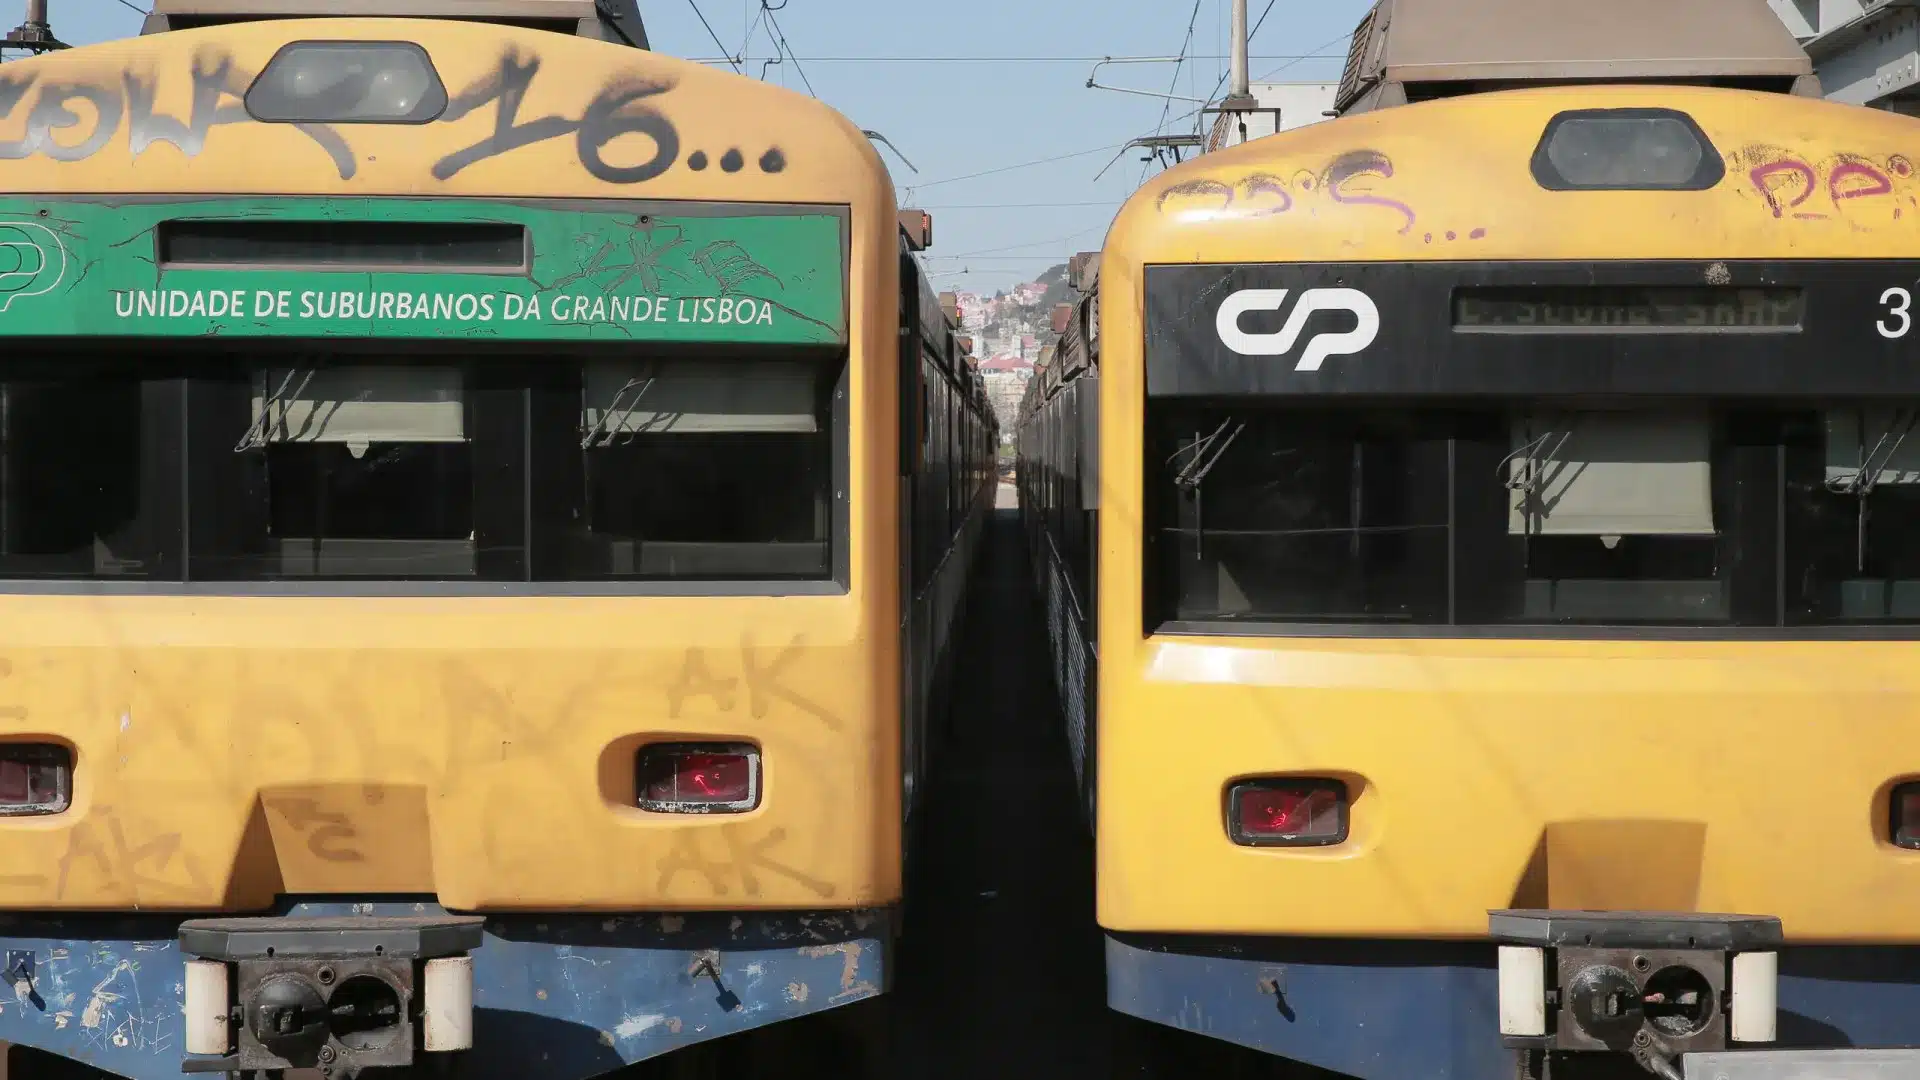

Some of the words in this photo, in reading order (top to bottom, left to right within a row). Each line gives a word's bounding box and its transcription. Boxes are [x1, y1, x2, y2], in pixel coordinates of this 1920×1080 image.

[115, 290, 246, 318] UNIDADE
[254, 290, 292, 318] DE
[299, 291, 495, 321] SUBURBANOS
[503, 294, 541, 320] DA
[551, 295, 670, 323] GRANDE
[678, 297, 773, 326] LISBOA
[1876, 286, 1912, 339] 3
